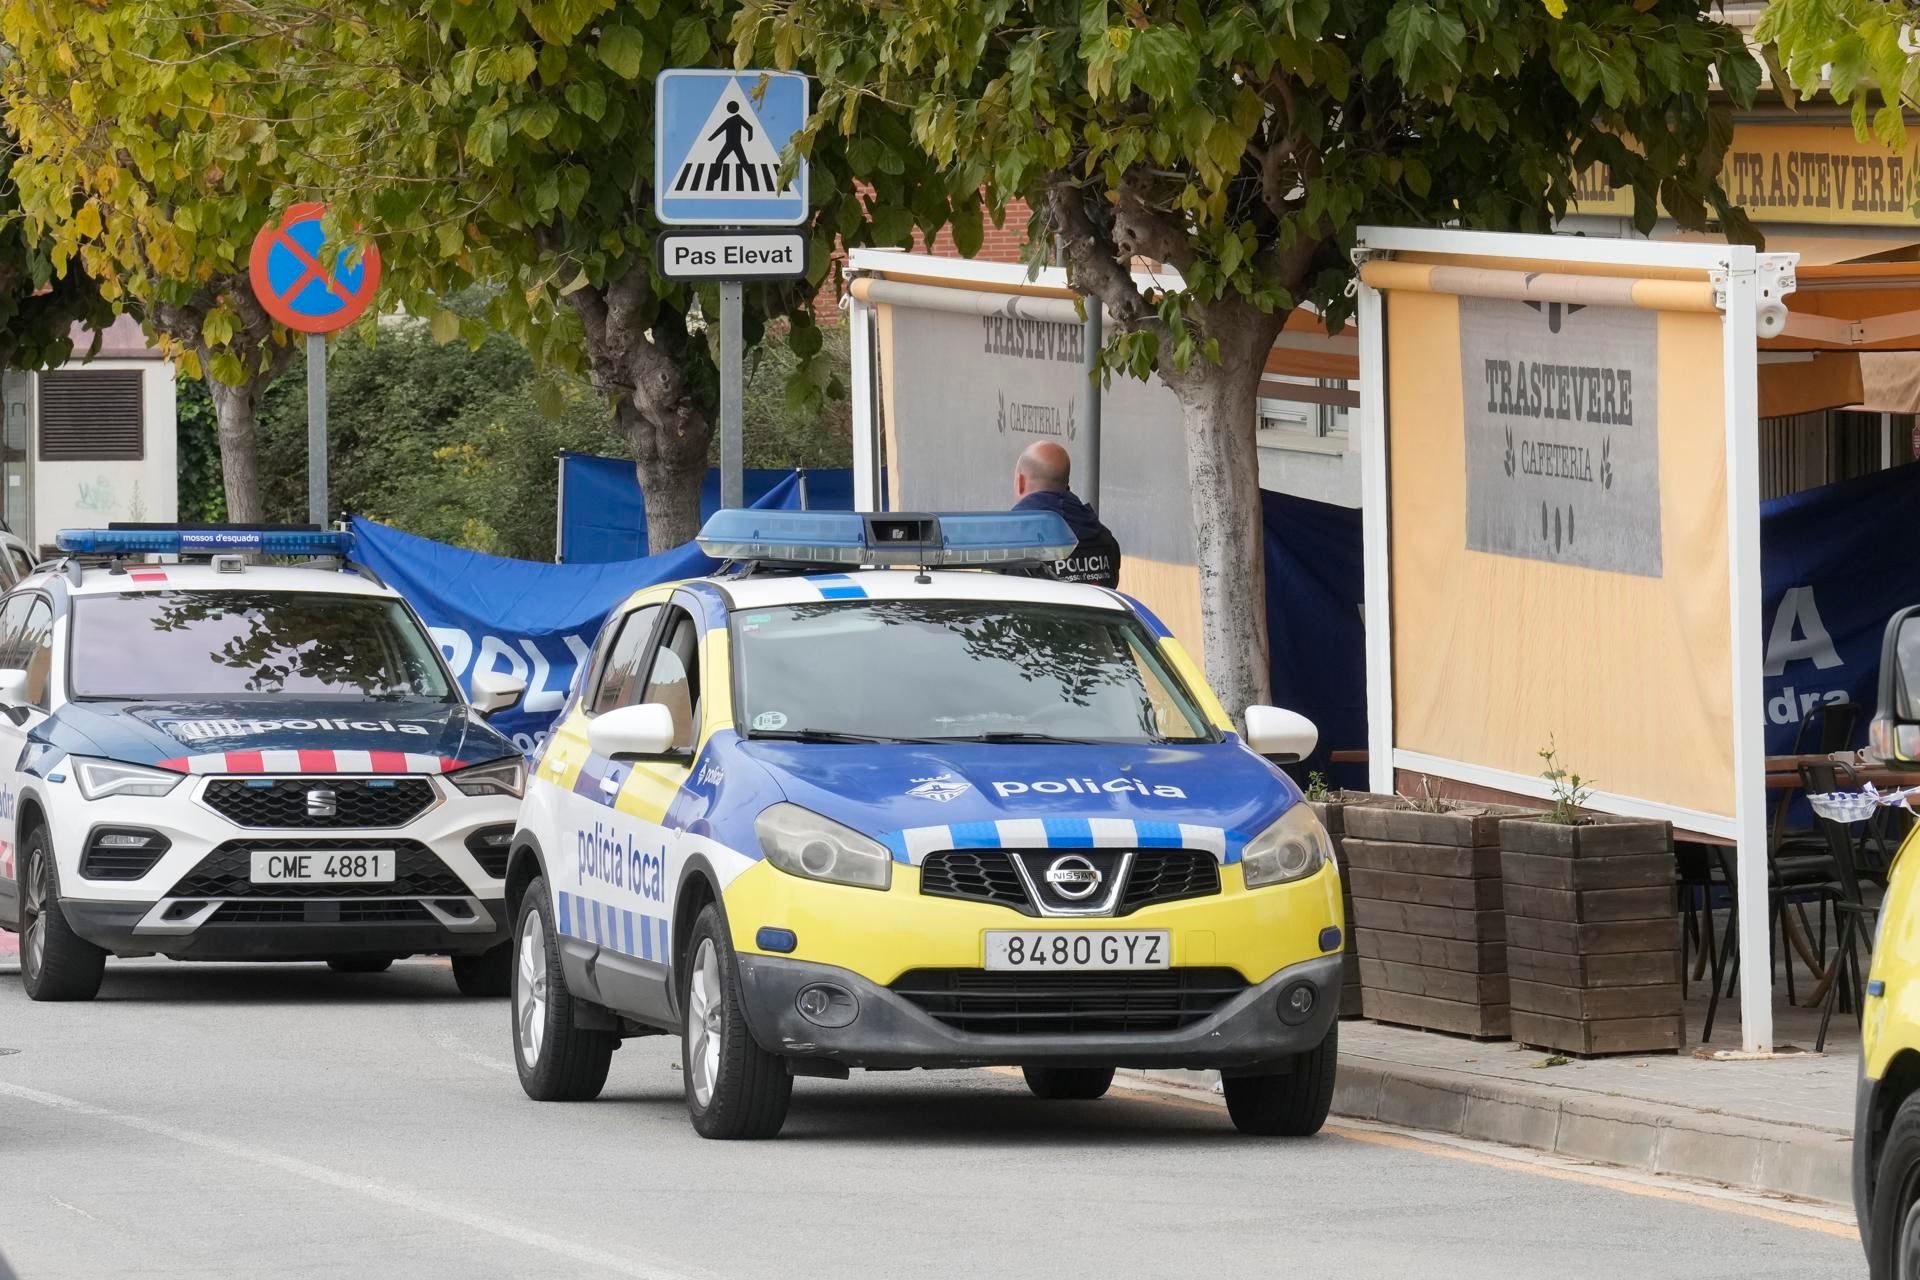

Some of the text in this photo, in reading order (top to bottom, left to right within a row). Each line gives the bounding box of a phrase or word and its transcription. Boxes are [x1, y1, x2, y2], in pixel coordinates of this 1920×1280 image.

[1733, 152, 1904, 213] TRASTEVERE
[675, 246, 793, 264] Pas Elevat
[1485, 359, 1633, 426] TRASTEVERE
[1010, 402, 1062, 436] CAFETERIA
[1521, 440, 1593, 482] CAFETERIA
[183, 533, 260, 543] mossos d'esquadra
[1055, 555, 1110, 575] POLICIA
[992, 778, 1187, 798] policia
[268, 855, 379, 878] CME 4881
[578, 821, 665, 903] policia local
[1053, 872, 1098, 880] NISSAN
[1008, 936, 1161, 965] 8480 GYZ
